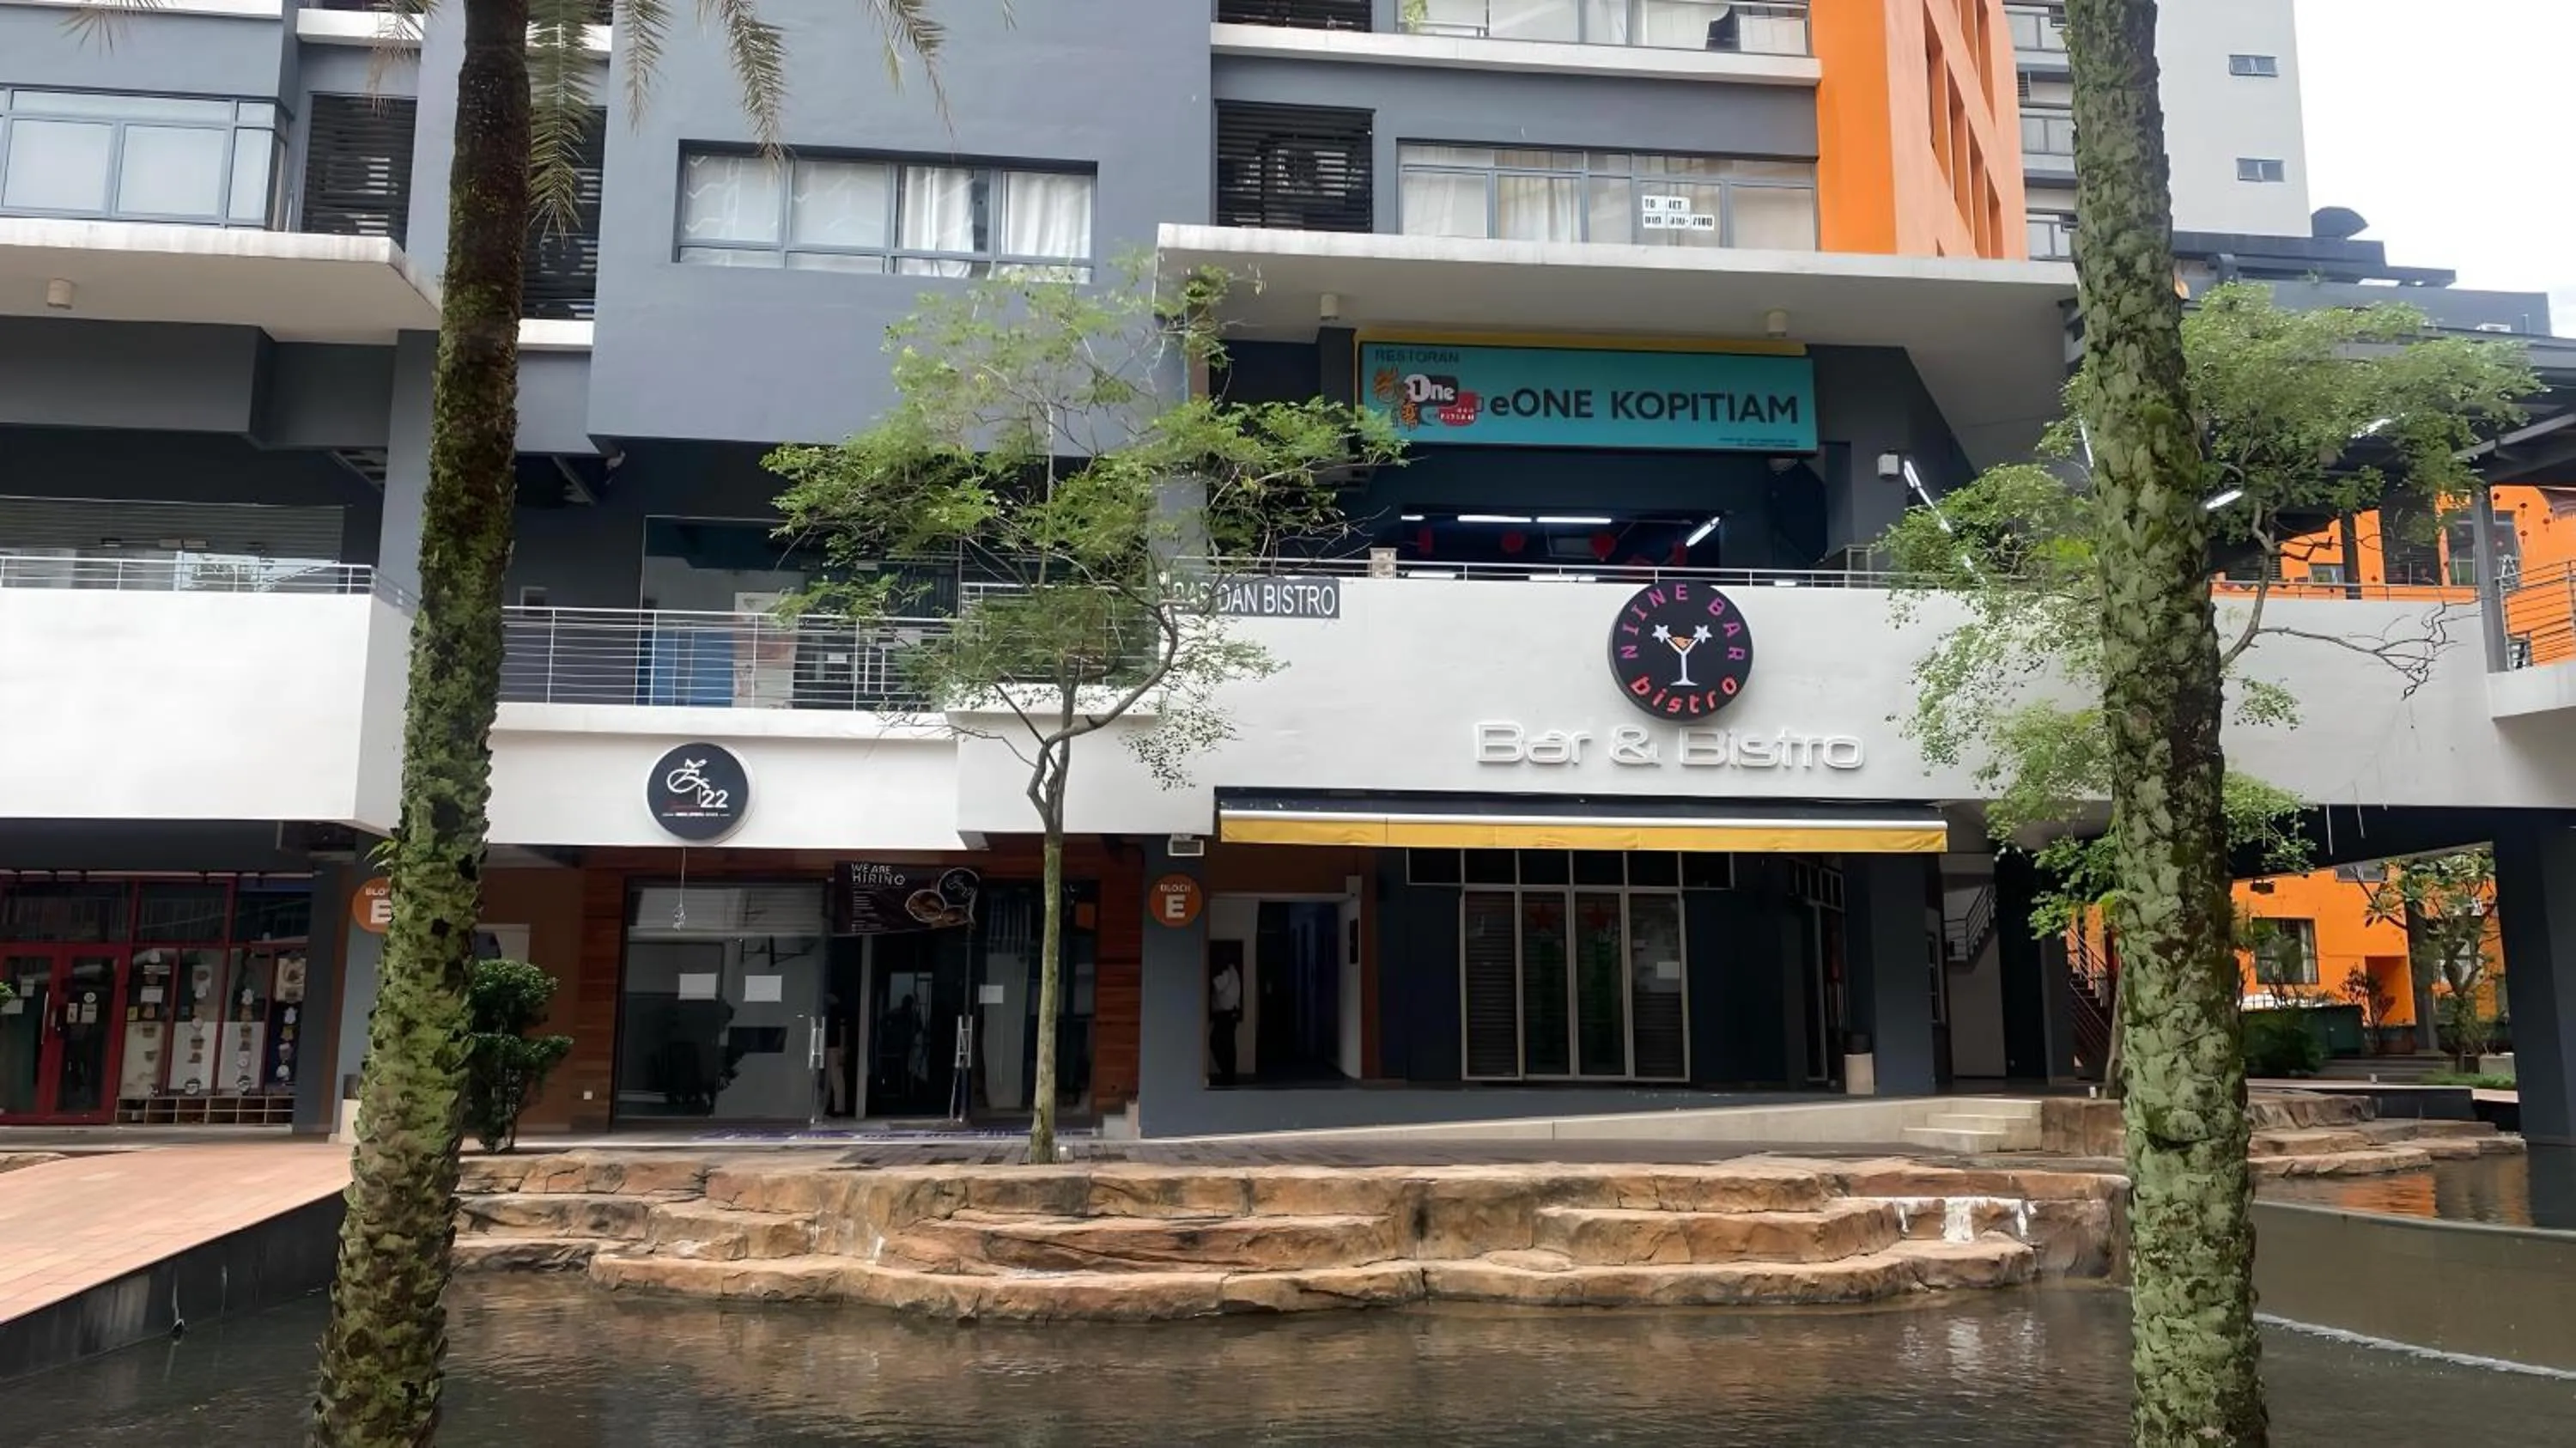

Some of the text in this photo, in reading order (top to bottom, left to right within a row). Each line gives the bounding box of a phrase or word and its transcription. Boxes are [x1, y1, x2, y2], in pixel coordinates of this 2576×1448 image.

[1374, 349, 1459, 363] RESTORAN
[1489, 388, 1799, 423] eONE KOPITIAM
[1263, 584, 1335, 615] BISTRO
[1706, 597, 1747, 660] BAR
[1631, 676, 1738, 714] bistro
[1473, 719, 1865, 770] Bar & Bistro
[700, 789, 729, 808] 22
[851, 863, 893, 874] WE ARE
[852, 872, 906, 885] HIRING
[370, 899, 392, 924] E
[1165, 893, 1186, 918] E
